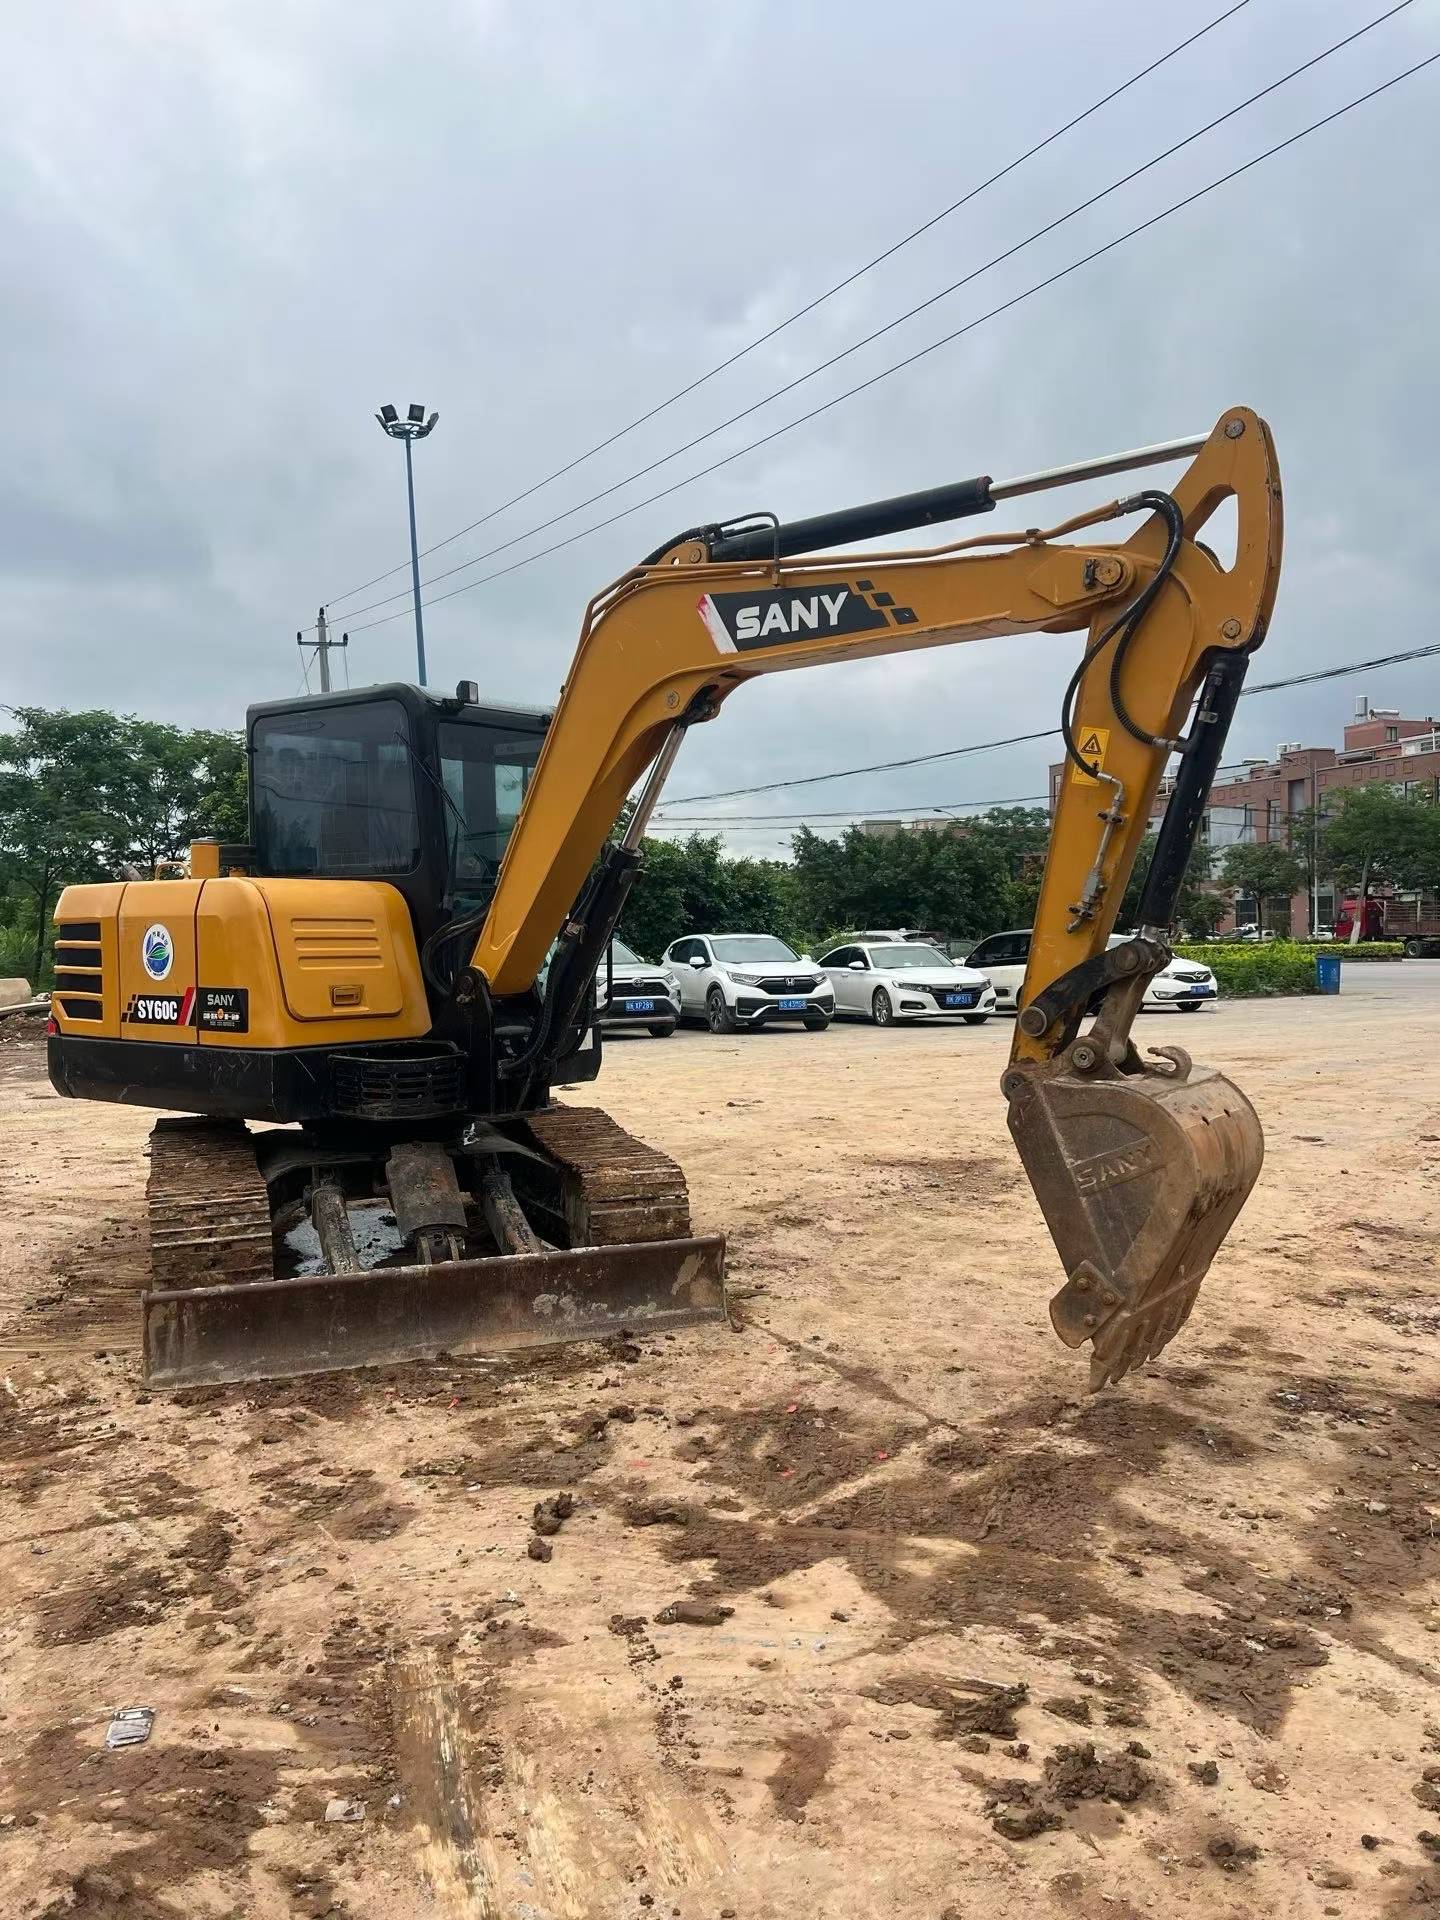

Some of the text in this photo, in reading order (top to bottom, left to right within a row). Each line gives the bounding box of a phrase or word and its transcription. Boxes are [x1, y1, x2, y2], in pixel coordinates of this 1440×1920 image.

[735, 591, 849, 640] SANY
[137, 999, 178, 1021] SY60C
[207, 994, 235, 1006] SANY
[1076, 1144, 1152, 1189] SANY
